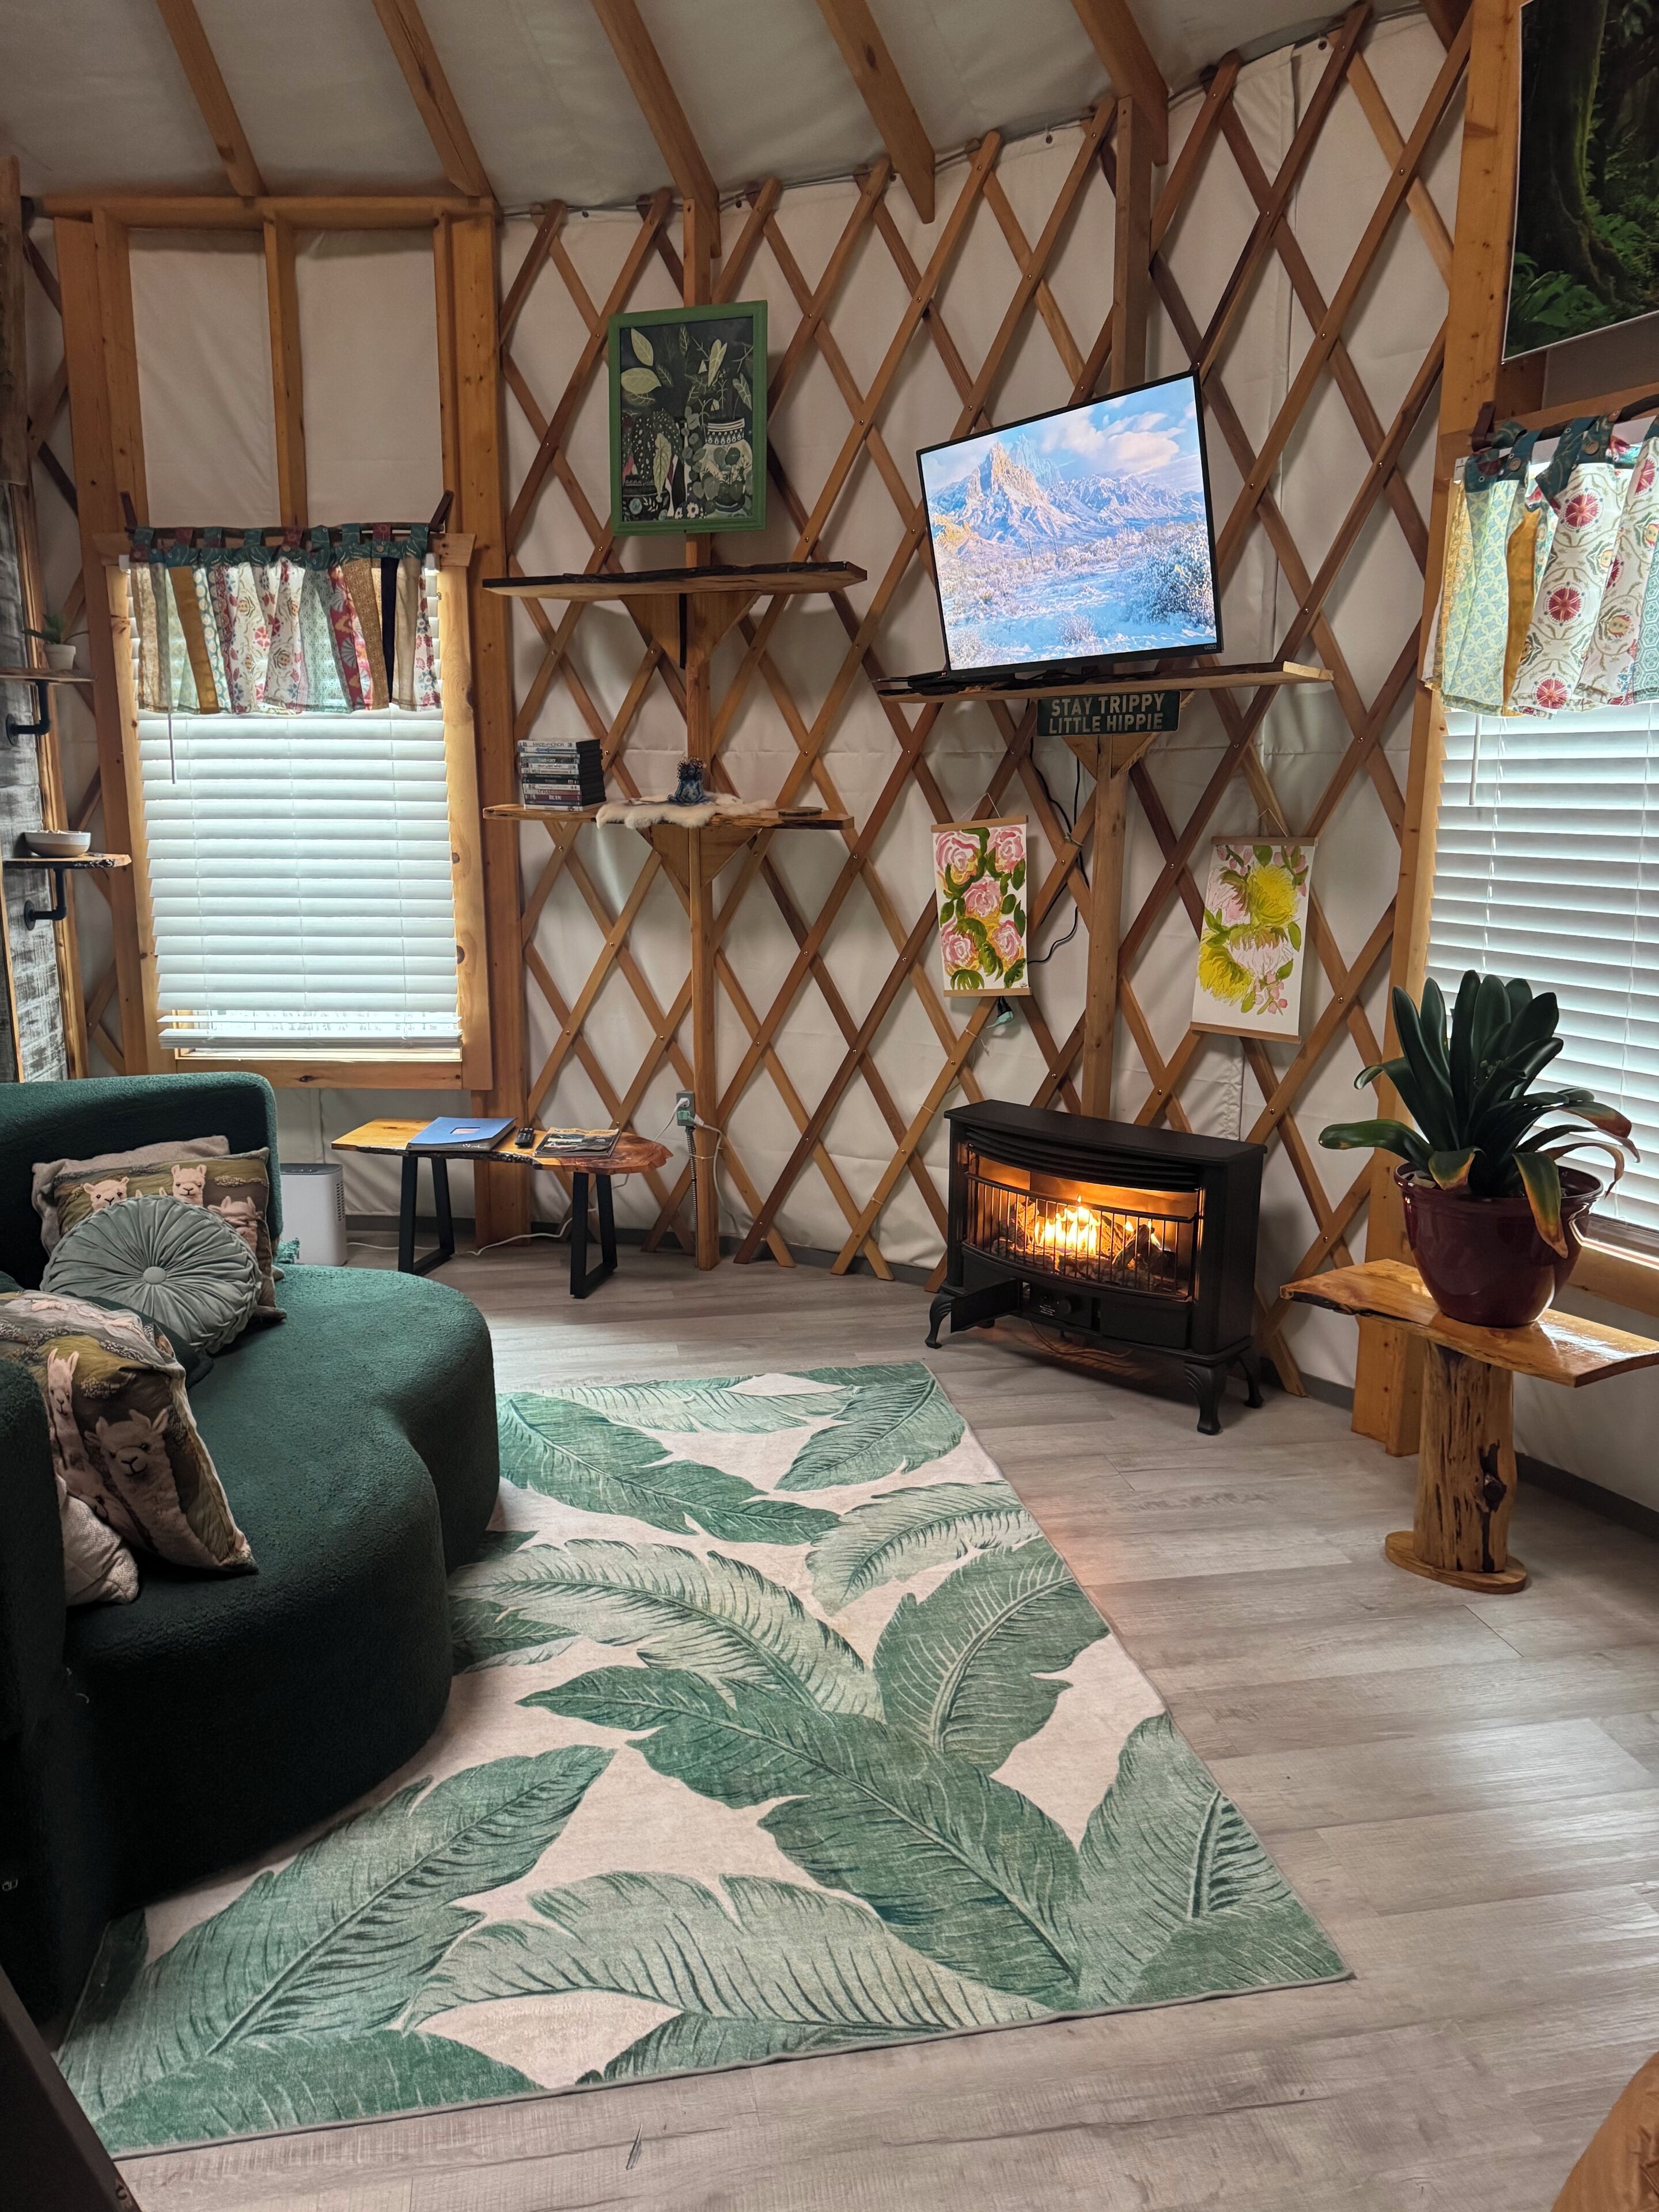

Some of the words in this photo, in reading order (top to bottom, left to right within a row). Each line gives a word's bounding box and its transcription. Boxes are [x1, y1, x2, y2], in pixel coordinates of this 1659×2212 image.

[1051, 697, 1093, 717] STAY
[1098, 693, 1165, 714] TRIPPY
[1049, 715, 1101, 734] LITTLE
[1107, 713, 1164, 732] HIPPIE
